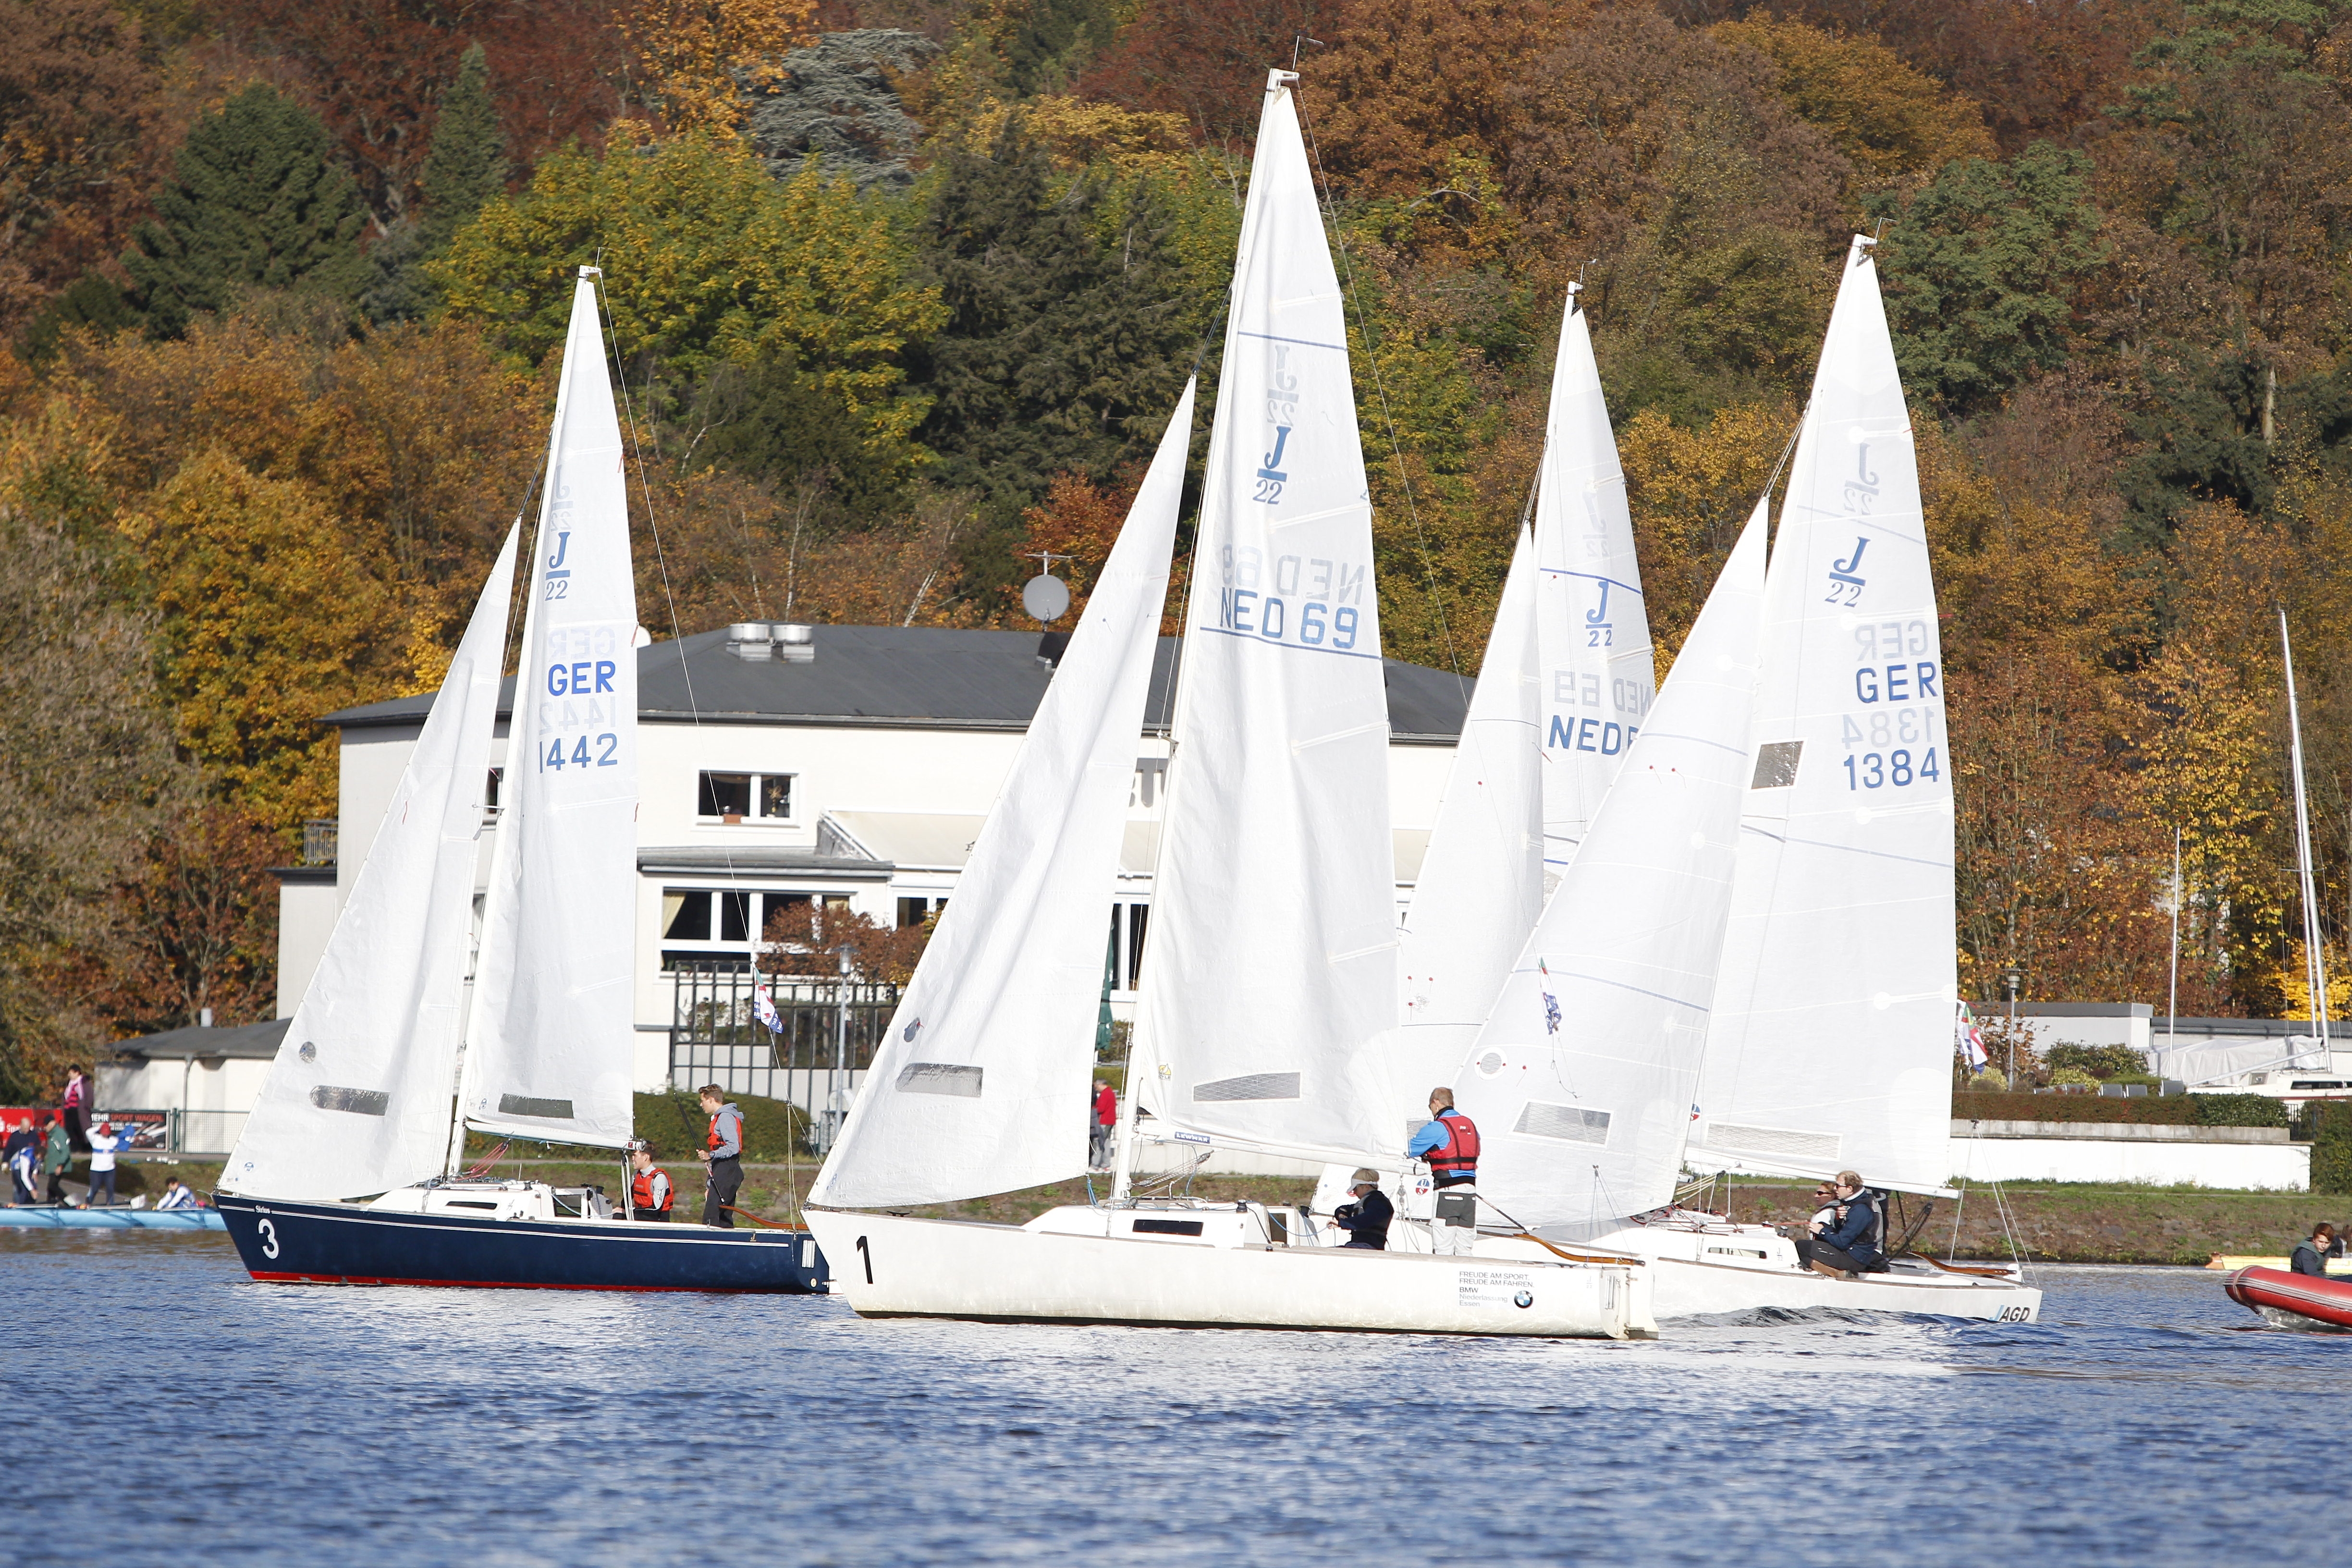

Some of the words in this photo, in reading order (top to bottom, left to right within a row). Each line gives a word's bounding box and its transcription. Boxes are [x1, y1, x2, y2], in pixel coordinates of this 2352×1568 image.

[1264, 426, 1291, 469] J
[1253, 480, 1282, 505] 22
[549, 532, 570, 569] J
[1833, 536, 1871, 574] J
[545, 581, 568, 600] 22
[1586, 581, 1609, 624] J
[1825, 582, 1862, 608] 22
[1220, 586, 1284, 639] NED
[1300, 603, 1359, 649] 69
[1588, 629, 1613, 647] 22
[548, 661, 615, 696] GER
[1856, 662, 1938, 704] GER
[539, 733, 617, 773] 1442
[1548, 715, 1621, 756] NED
[1843, 747, 1940, 791] 1384
[258, 1218, 279, 1259] 3
[856, 1236, 873, 1284] 1
[1459, 1294, 1507, 1303] Niederlassung
[1989, 1305, 2030, 1322] JAGD
